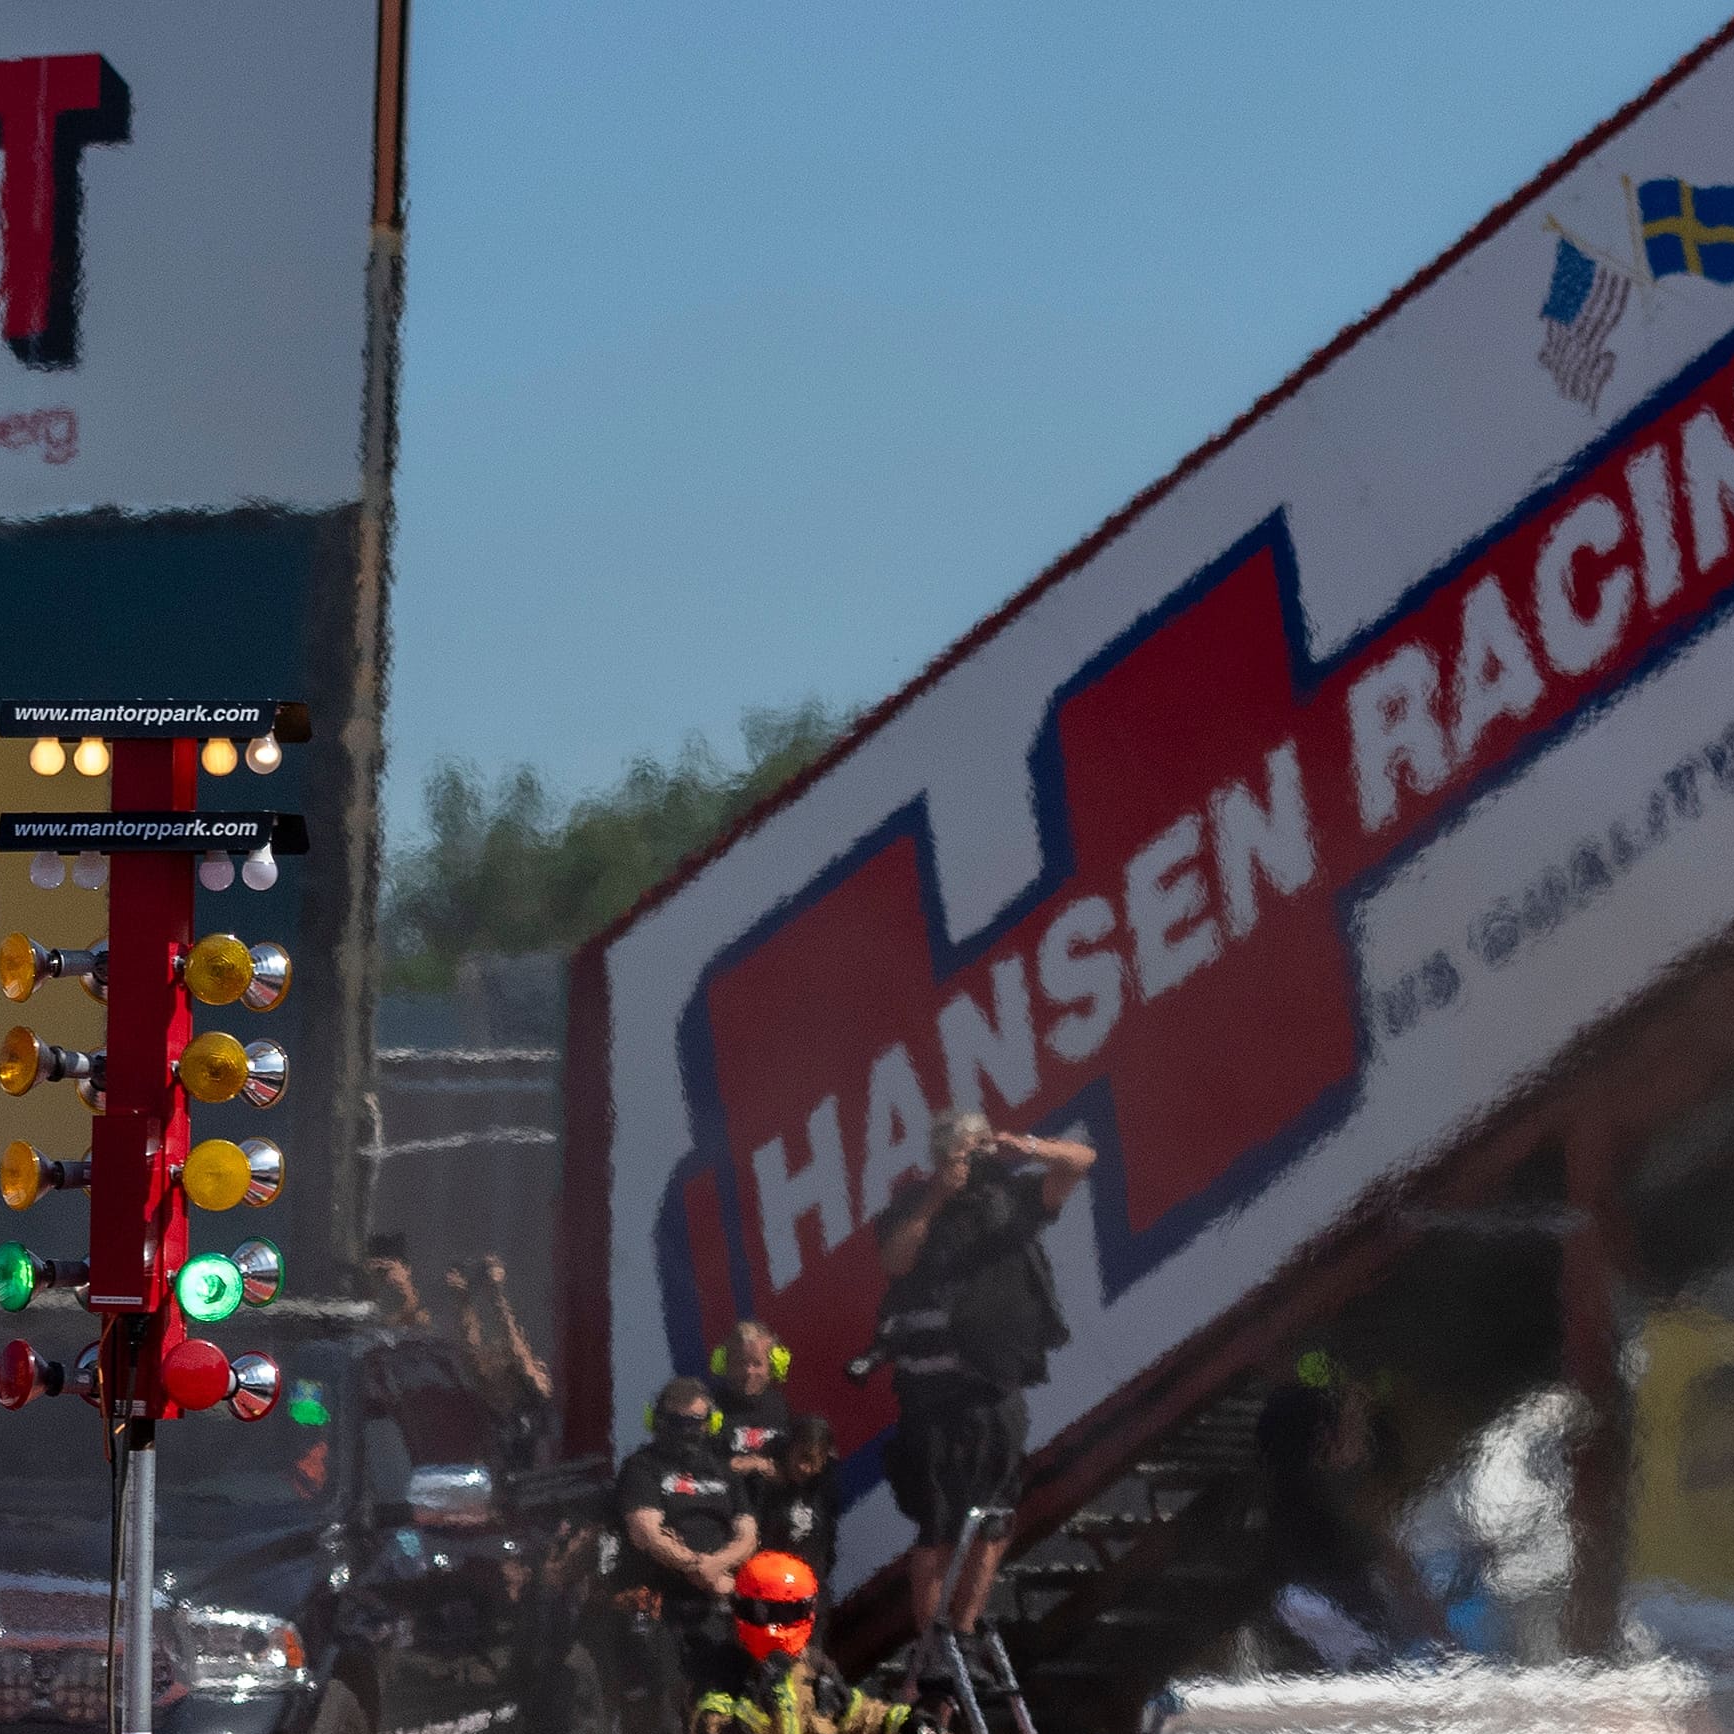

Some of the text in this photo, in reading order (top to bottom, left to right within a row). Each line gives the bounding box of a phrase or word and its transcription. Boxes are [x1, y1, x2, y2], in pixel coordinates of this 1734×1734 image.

[15, 704, 260, 726] www.mantorppark.com
[14, 818, 258, 841] www.mantorppark.com
[751, 742, 1317, 1294] HANSEN
